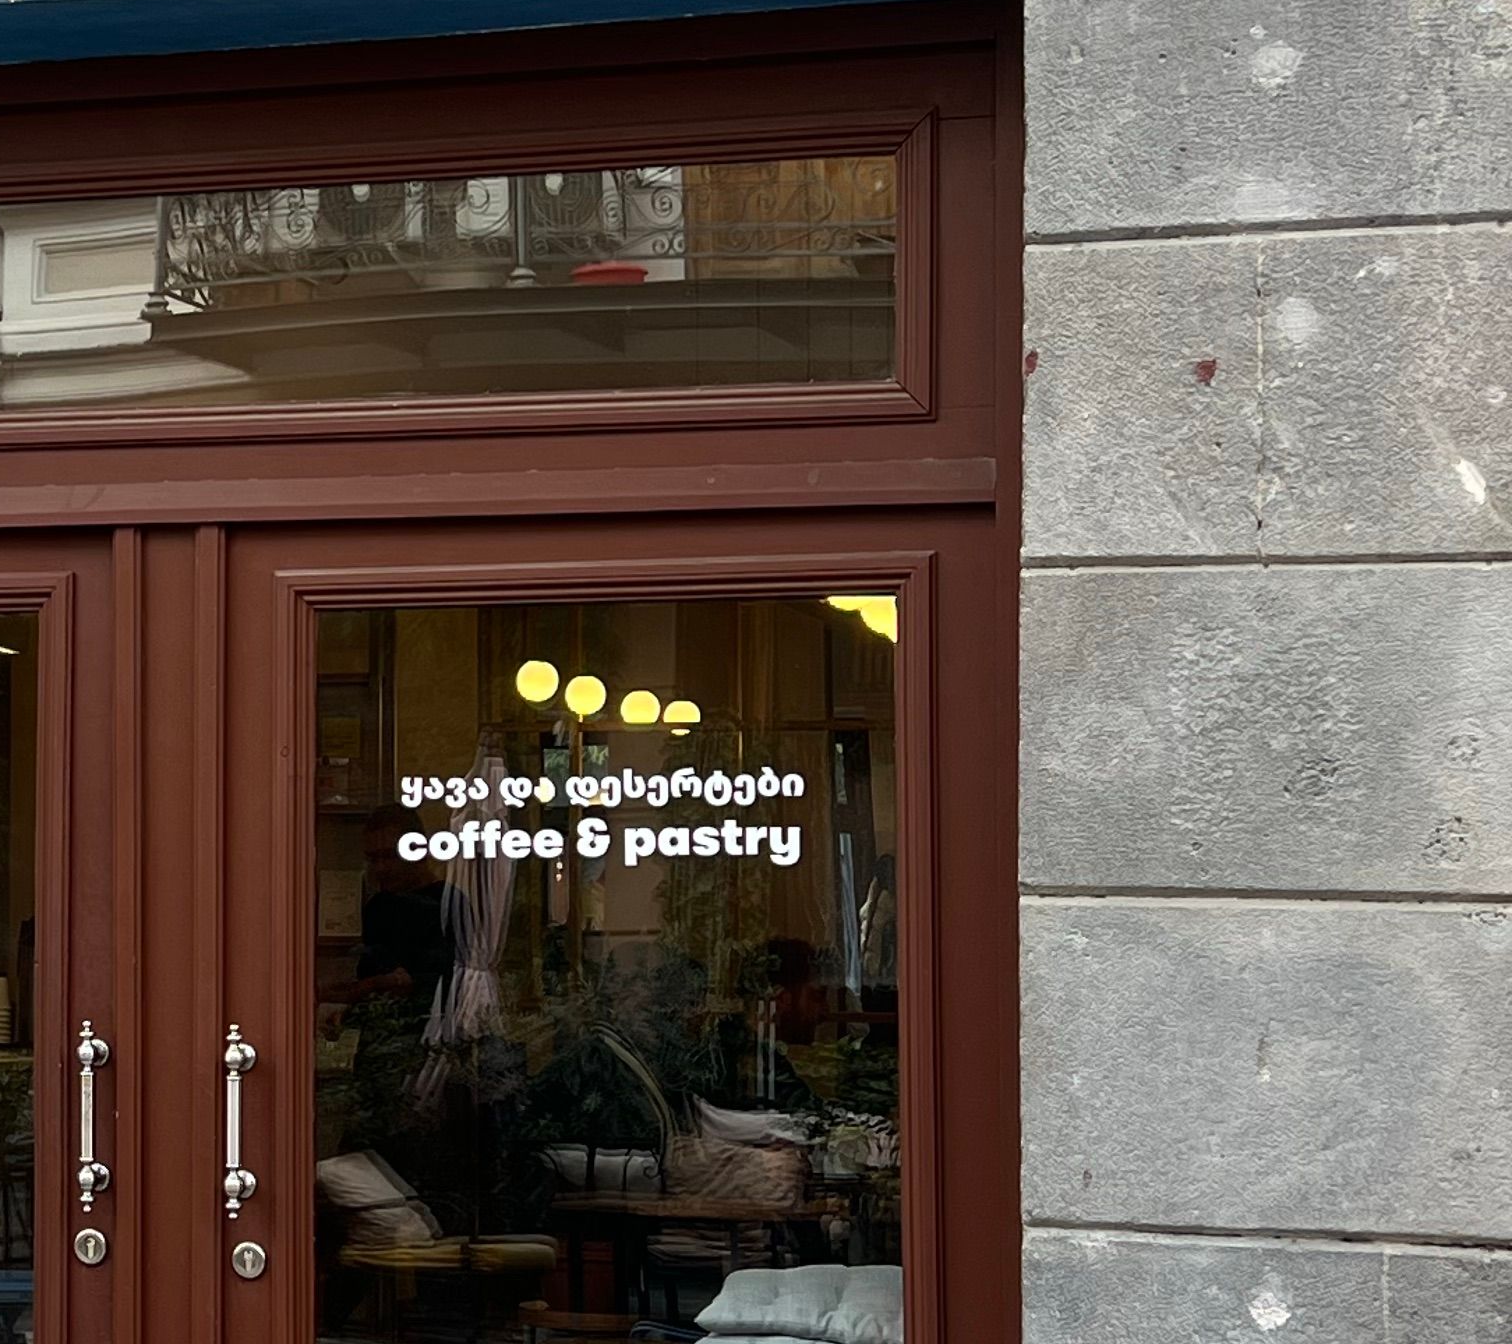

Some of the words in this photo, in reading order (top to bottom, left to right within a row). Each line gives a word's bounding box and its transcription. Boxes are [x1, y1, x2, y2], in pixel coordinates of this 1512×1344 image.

[400, 775, 490, 808] ყავა
[500, 774, 556, 808] და
[565, 767, 805, 807] დესერტები
[397, 820, 565, 862] coffee
[576, 817, 611, 858] &
[623, 819, 802, 866] pastry
